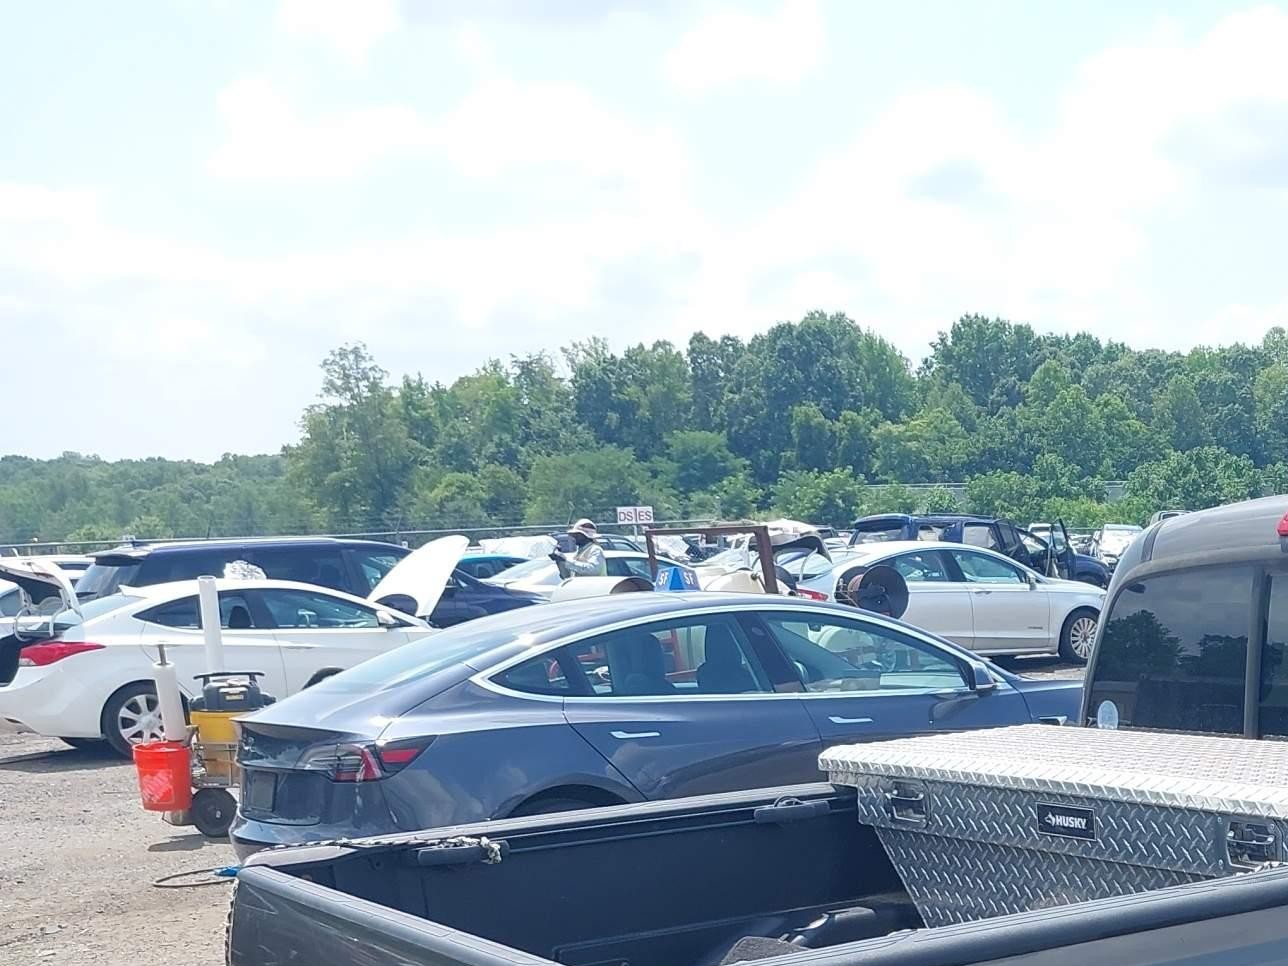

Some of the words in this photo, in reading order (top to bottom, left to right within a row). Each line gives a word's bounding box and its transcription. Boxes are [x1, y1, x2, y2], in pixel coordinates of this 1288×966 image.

[618, 511, 634, 521] DS
[638, 510, 652, 520] ES
[1055, 814, 1087, 829] HUSKY
